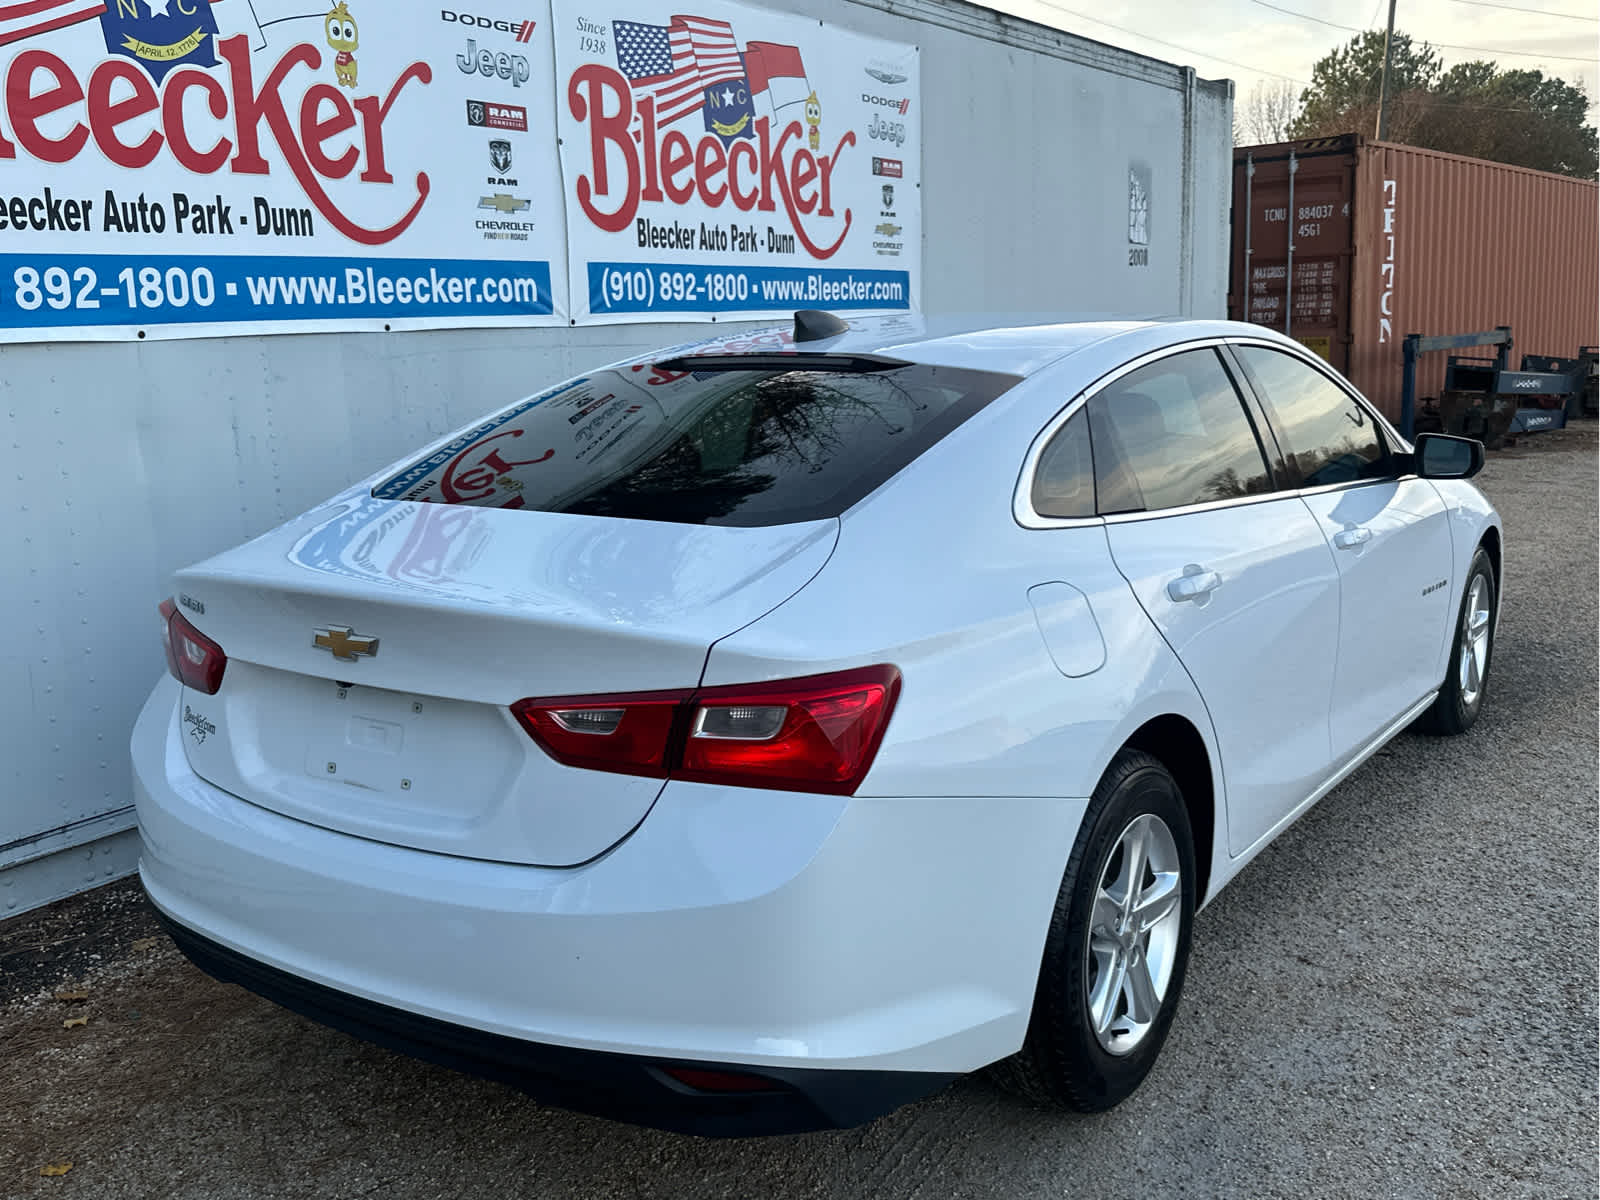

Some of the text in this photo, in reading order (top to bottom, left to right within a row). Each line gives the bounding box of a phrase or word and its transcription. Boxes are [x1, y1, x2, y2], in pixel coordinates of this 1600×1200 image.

[441, 10, 526, 36] DODGE
[576, 16, 607, 36] Since
[138, 45, 164, 58] APRIL
[579, 36, 607, 55] 1938
[456, 38, 530, 88] Jeep
[861, 93, 904, 109] DODGE
[488, 107, 524, 120] RAM
[0, 33, 433, 246] eecker
[868, 113, 905, 148] Jeep
[568, 63, 857, 261] Bleecker
[487, 177, 518, 187] RAM
[103, 189, 166, 234] Auto
[173, 192, 234, 236] Park
[253, 196, 315, 237] Dunn
[1263, 202, 1351, 222] TCNU 884037 4
[475, 220, 535, 232] CHEVROLET
[636, 217, 796, 254] Bleecker Auto Park Dunn
[1297, 223, 1321, 238] 45G1
[13, 266, 538, 310] 892-1800 www.Bleecker.com
[602, 267, 902, 308] (910) 892-1800 www.Bleecker.com
